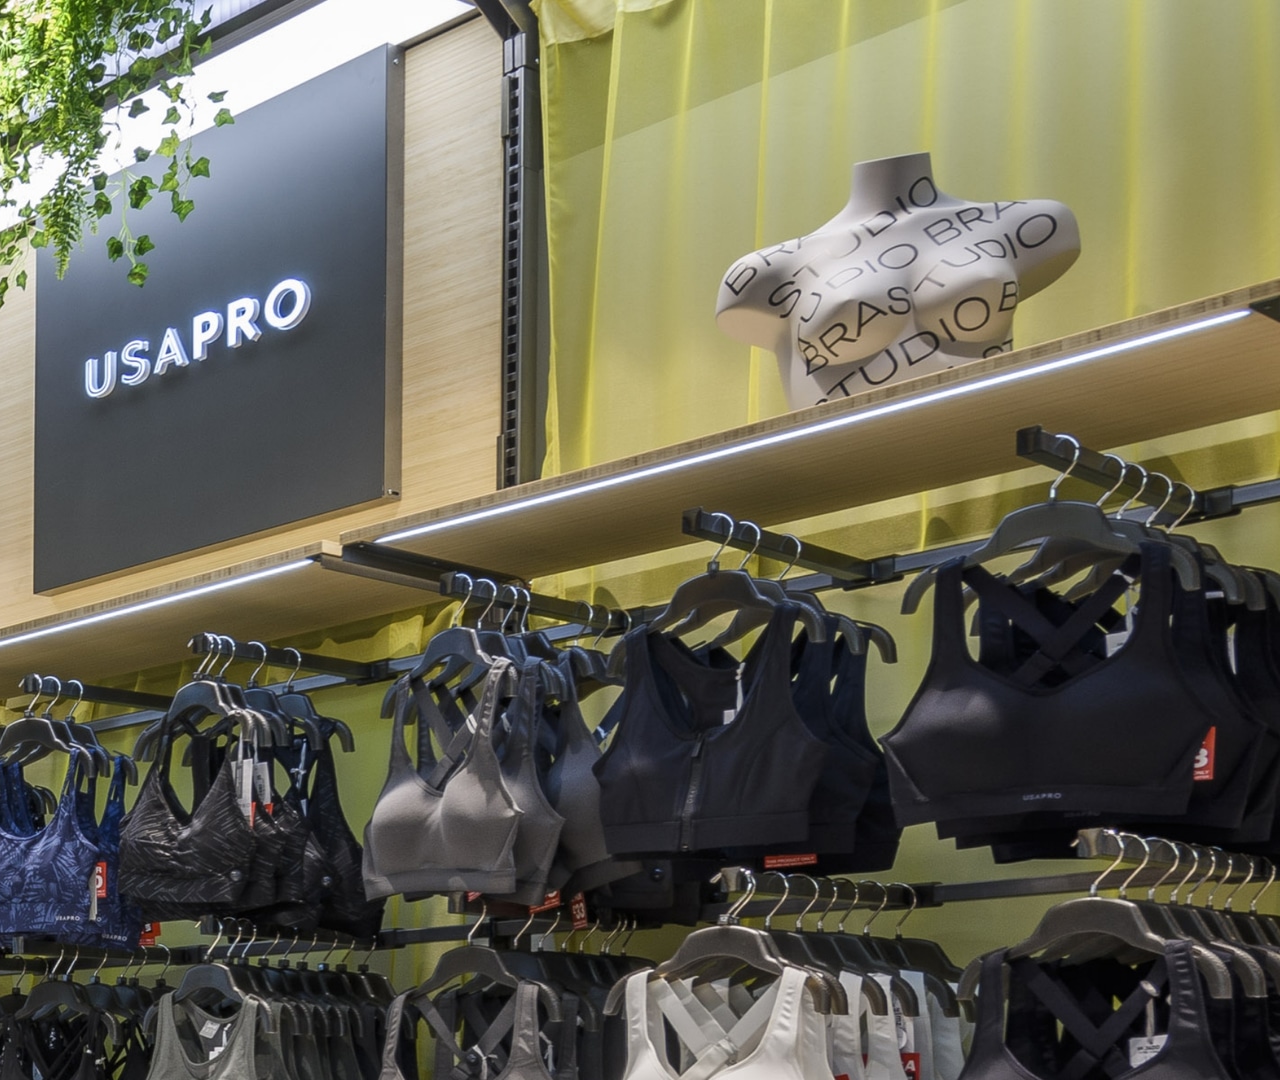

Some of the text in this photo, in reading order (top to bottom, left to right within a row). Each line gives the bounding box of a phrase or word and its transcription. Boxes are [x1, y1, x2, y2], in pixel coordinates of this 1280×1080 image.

[84, 278, 311, 399] USAPRO
[803, 213, 1058, 376] BRA STUDIO
[1022, 792, 1062, 801] USAPRO
